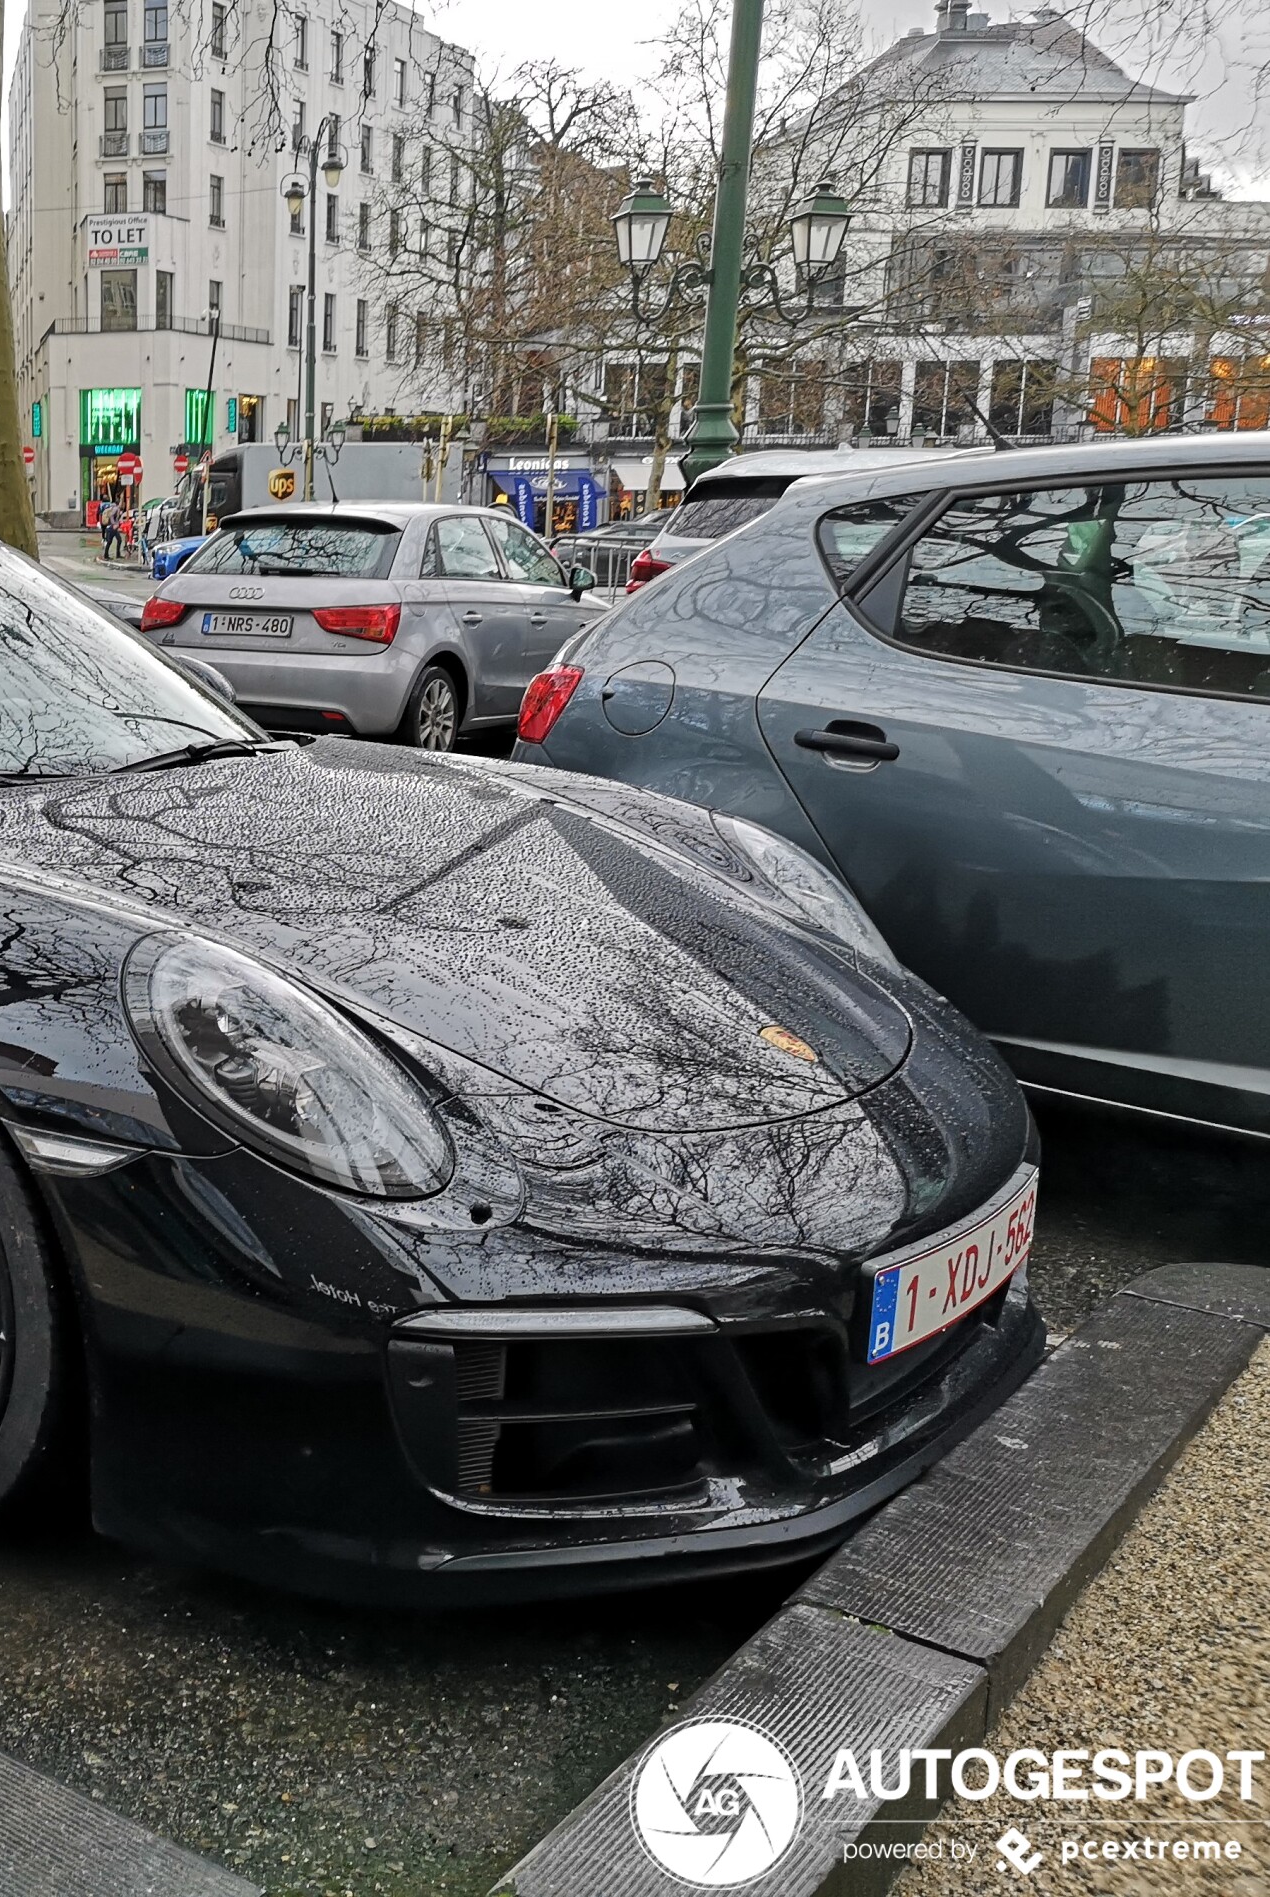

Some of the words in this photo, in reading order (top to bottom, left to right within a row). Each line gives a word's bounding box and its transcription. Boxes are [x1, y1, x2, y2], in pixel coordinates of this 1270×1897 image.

[89, 218, 127, 228] Prestigious
[129, 216, 148, 225] Office
[91, 229, 113, 245] TO
[117, 227, 146, 244] LET
[270, 478, 294, 497] ups
[212, 616, 289, 633] 1-NRS-480
[875, 1320, 891, 1351] B
[906, 1189, 1036, 1333] 1-XDJ-562
